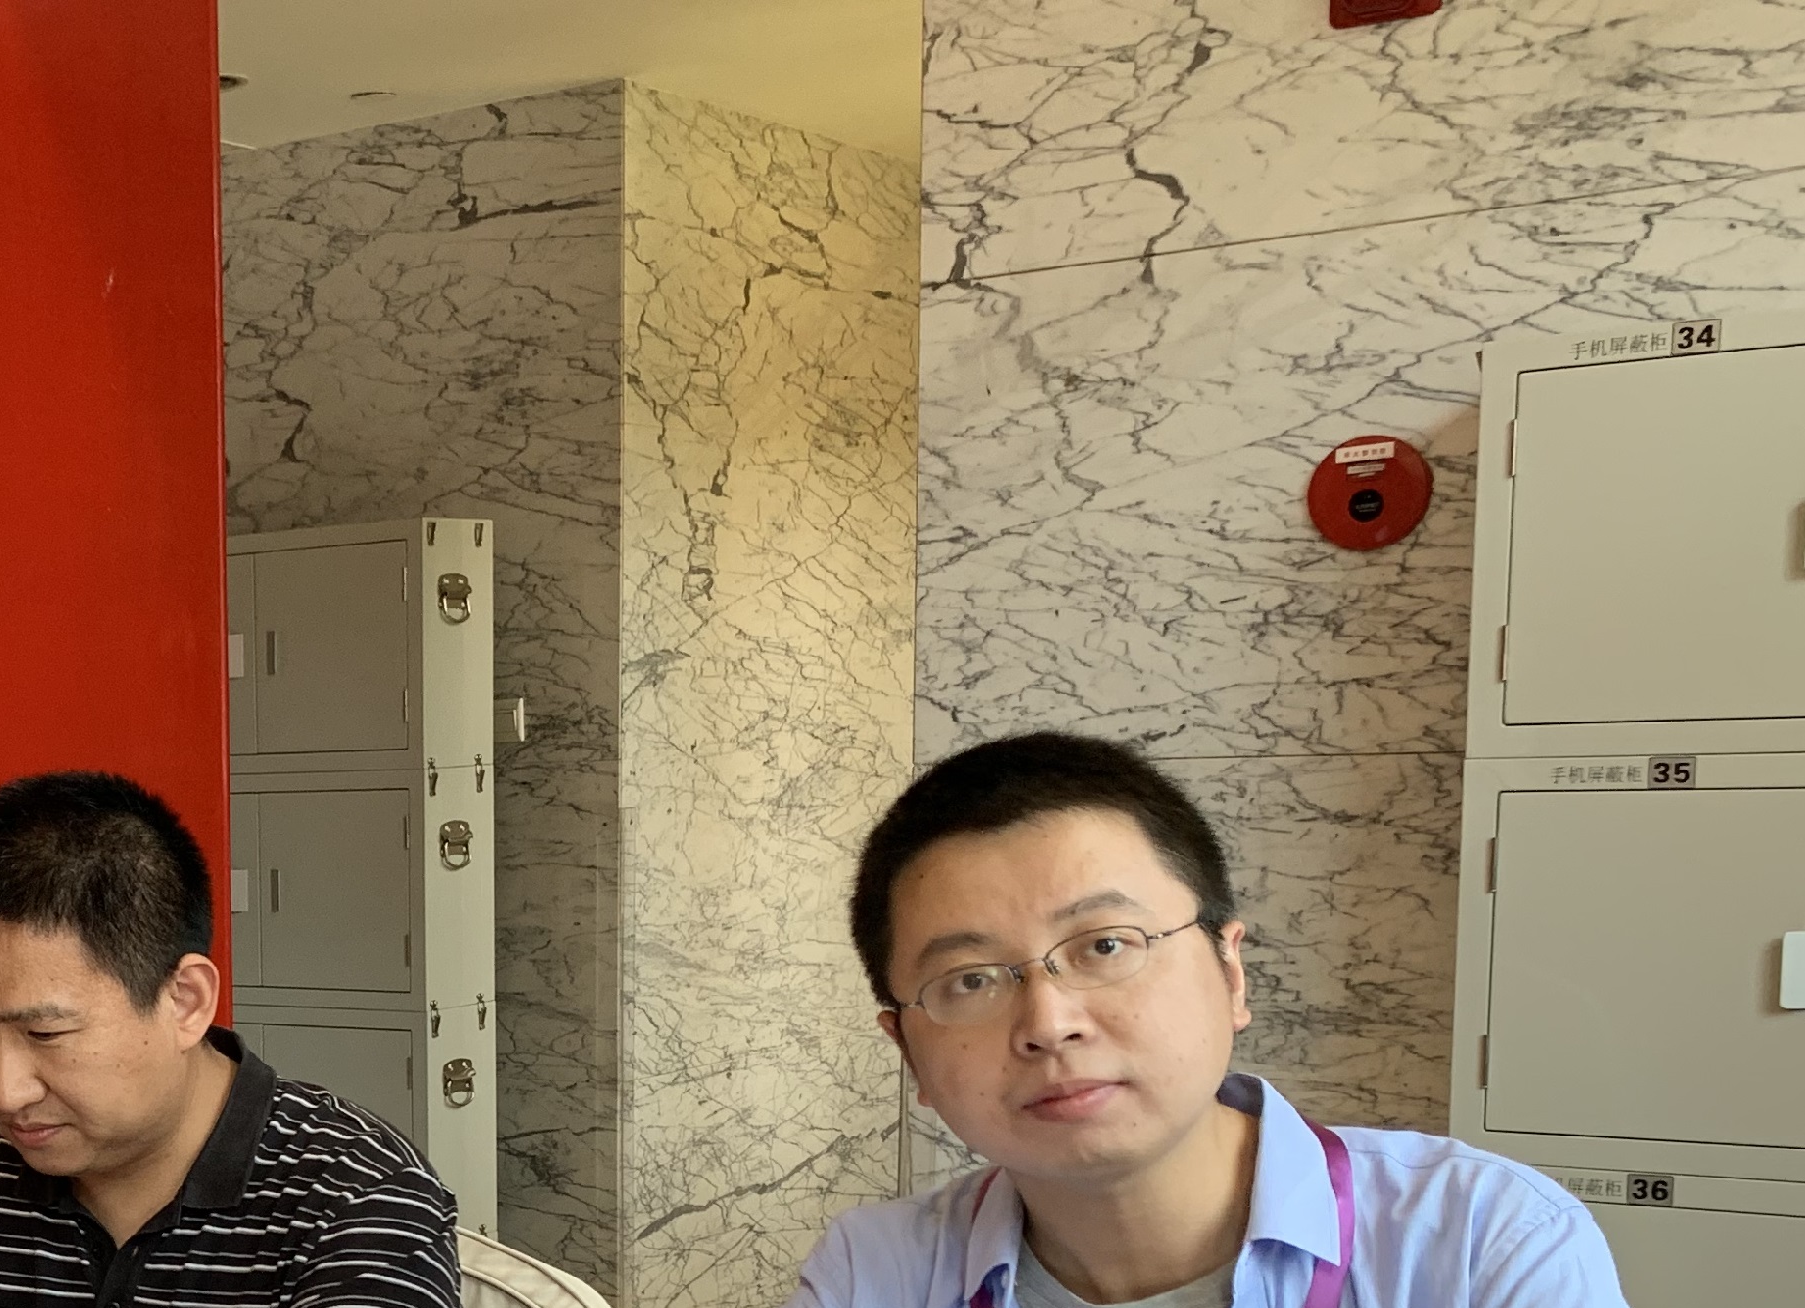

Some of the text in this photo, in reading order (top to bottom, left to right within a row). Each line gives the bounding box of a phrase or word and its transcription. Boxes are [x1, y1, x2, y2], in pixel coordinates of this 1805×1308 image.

[1569, 324, 1716, 360] 手机屏蔽柜 34
[1551, 762, 1691, 784] 手机屏蔽柜 35
[1632, 1178, 1669, 1201] 36
